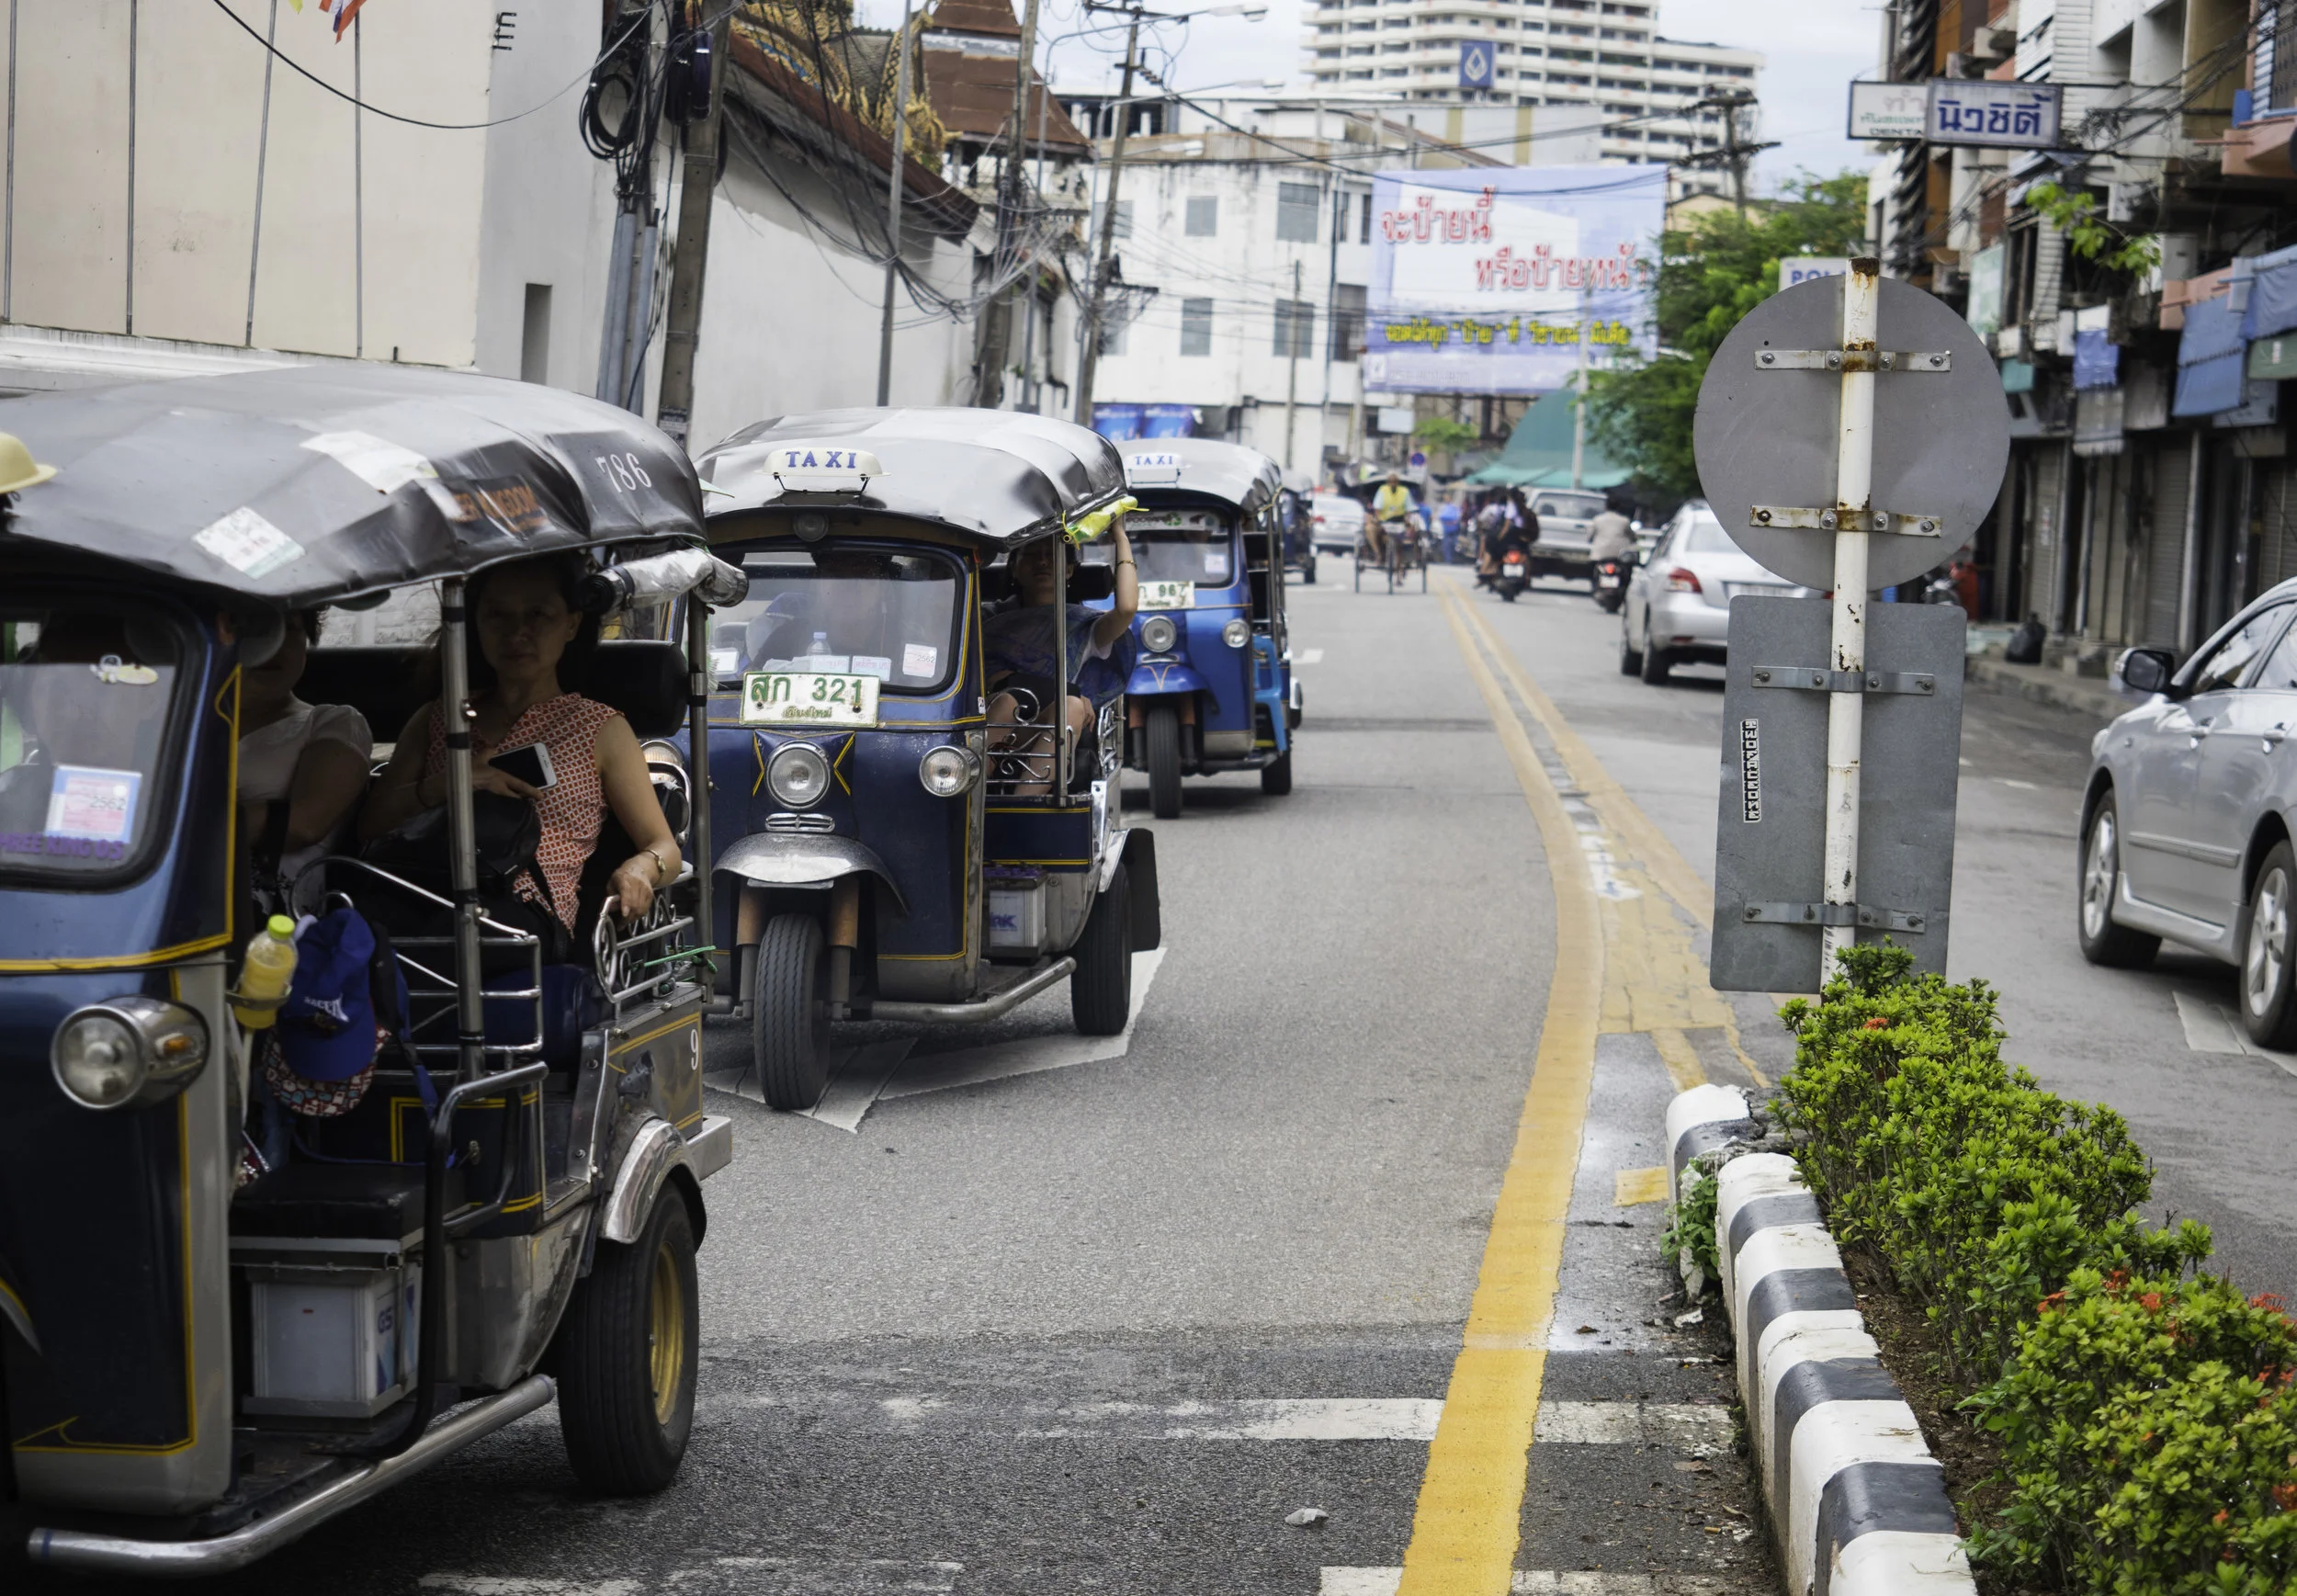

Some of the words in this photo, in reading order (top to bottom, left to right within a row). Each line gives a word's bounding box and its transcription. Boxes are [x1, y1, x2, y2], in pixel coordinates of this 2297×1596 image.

[786, 450, 856, 469] TAXI
[1134, 455, 1173, 465] TAXI
[595, 452, 652, 493] 786
[751, 675, 791, 702] สก
[812, 677, 862, 704] 321
[90, 796, 127, 810] 2562
[690, 1029, 699, 1070] 9
